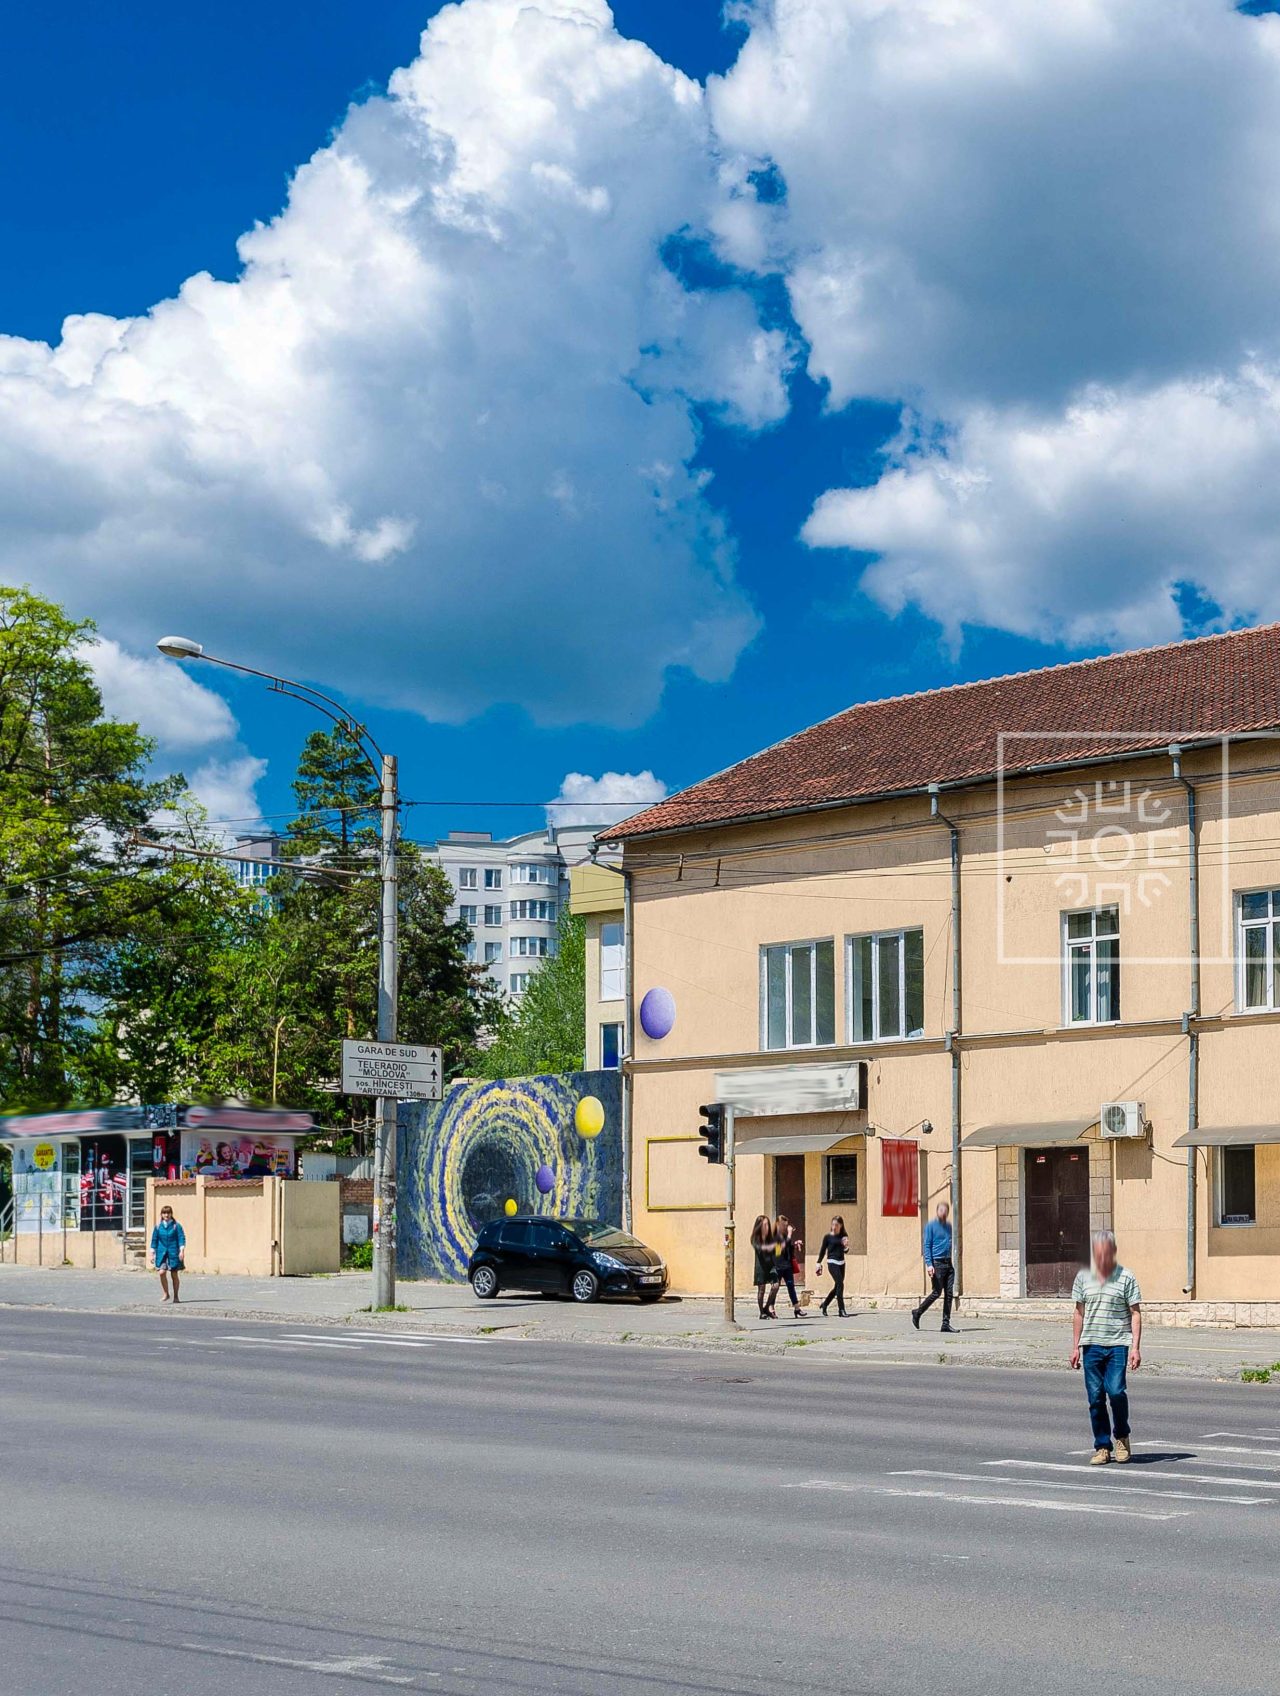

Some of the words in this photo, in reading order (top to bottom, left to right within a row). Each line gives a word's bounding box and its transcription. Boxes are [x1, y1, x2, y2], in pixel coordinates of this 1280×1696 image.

[357, 1045, 383, 1055] GARA
[385, 1047, 397, 1056] DE
[399, 1049, 418, 1058] SUD
[358, 1060, 408, 1072] TELERADIO
